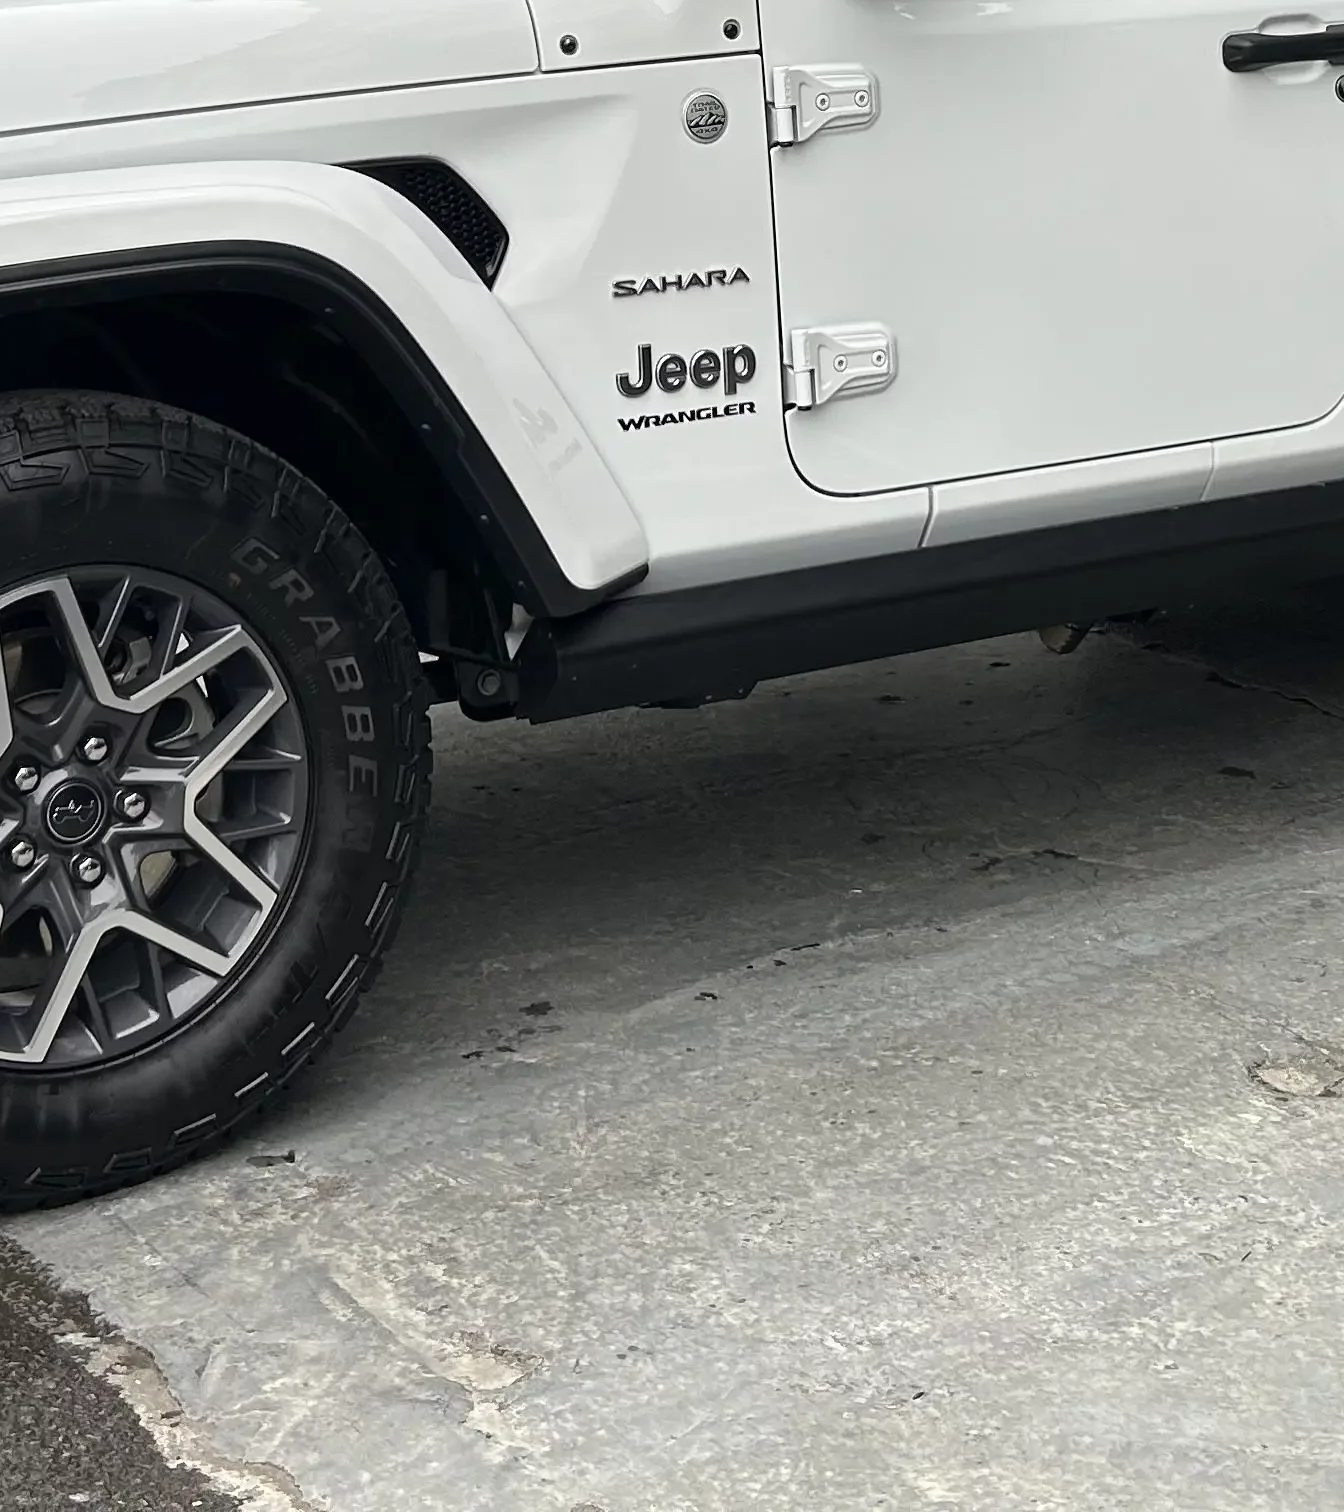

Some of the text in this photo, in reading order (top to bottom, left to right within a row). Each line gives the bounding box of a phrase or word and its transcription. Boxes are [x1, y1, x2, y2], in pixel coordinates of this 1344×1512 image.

[611, 266, 751, 298] SAHARA
[616, 342, 757, 398] Jeep
[616, 400, 757, 432] WRANGLER
